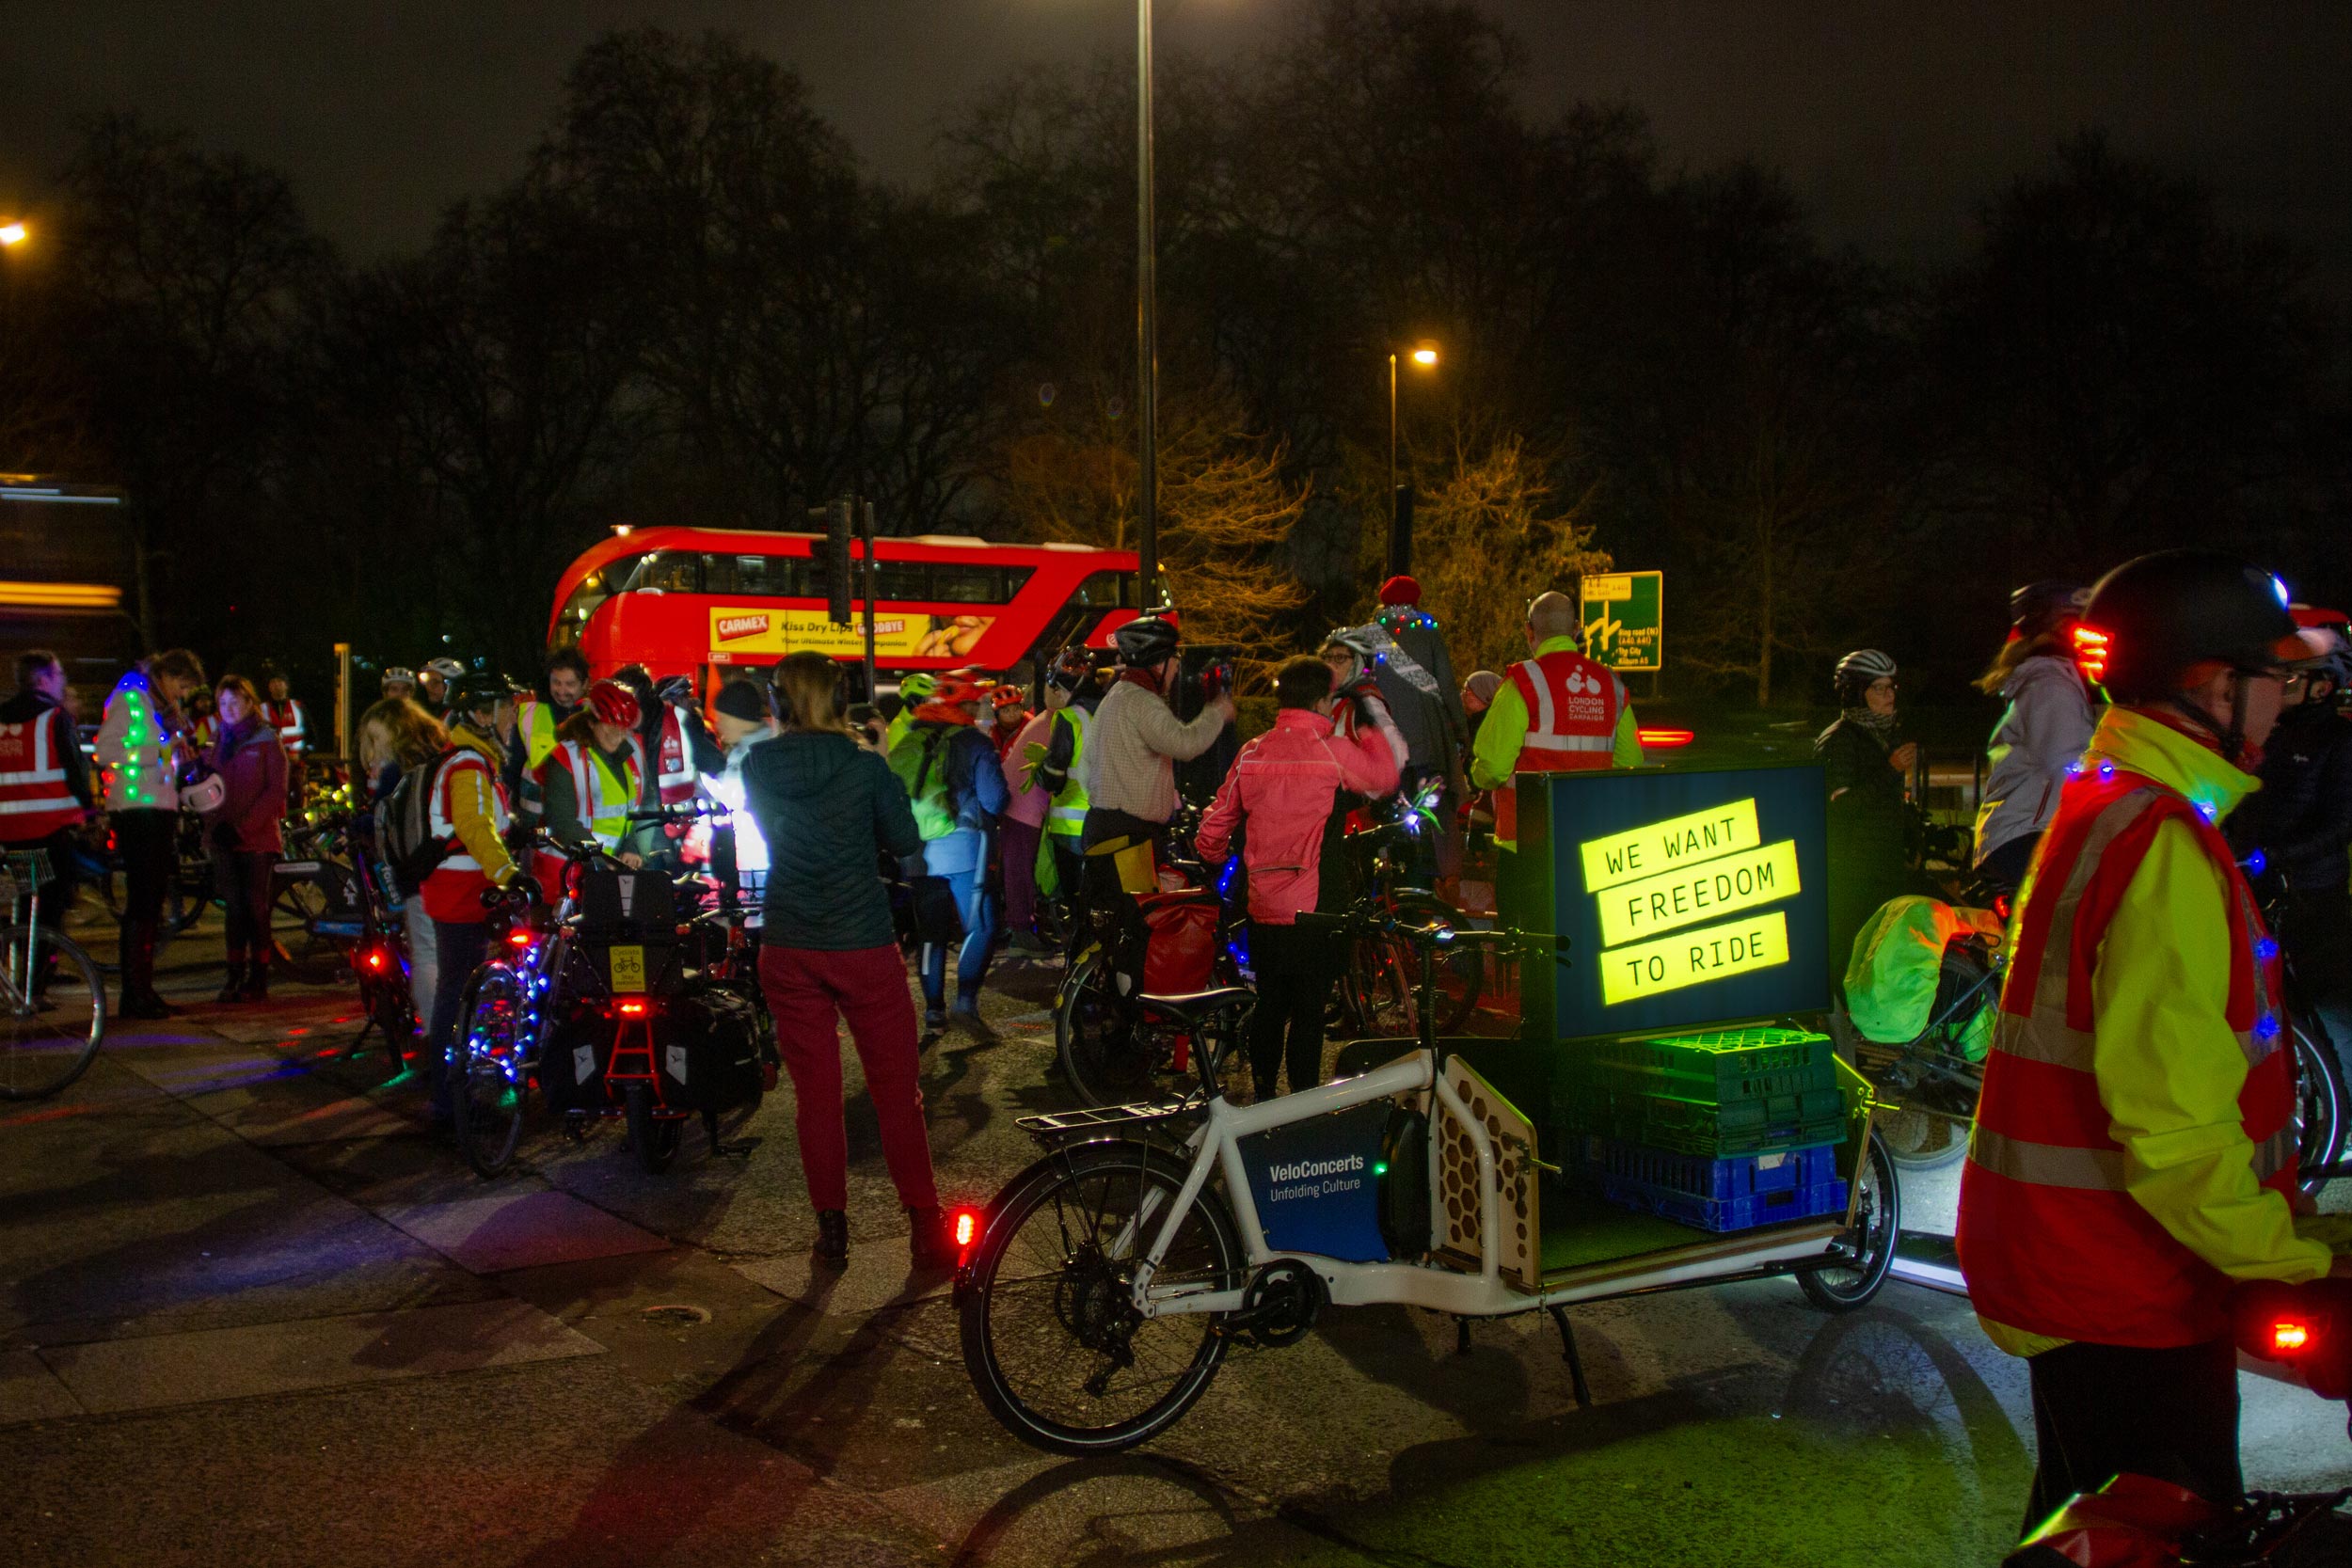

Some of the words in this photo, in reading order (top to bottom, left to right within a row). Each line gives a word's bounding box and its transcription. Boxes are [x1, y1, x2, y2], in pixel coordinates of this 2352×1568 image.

[719, 615, 767, 634] CARMEX
[781, 622, 803, 631] Kiss
[807, 623, 827, 634] Dry
[1618, 628, 1630, 637] Ring
[1646, 626, 1659, 636] (N)
[1629, 646, 1642, 656] City
[1568, 696, 1604, 705] LONDON
[1568, 705, 1604, 714] CYCLING
[1605, 843, 1642, 876] WE
[1662, 816, 1736, 859] WANT
[1628, 862, 1775, 927] FREEDOM
[1627, 955, 1665, 987] TO
[1690, 931, 1765, 973] RIDE
[1269, 1154, 1364, 1182] VeloConcerts
[1270, 1183, 1320, 1202] Unfolding
[1323, 1179, 1360, 1194] Culture
